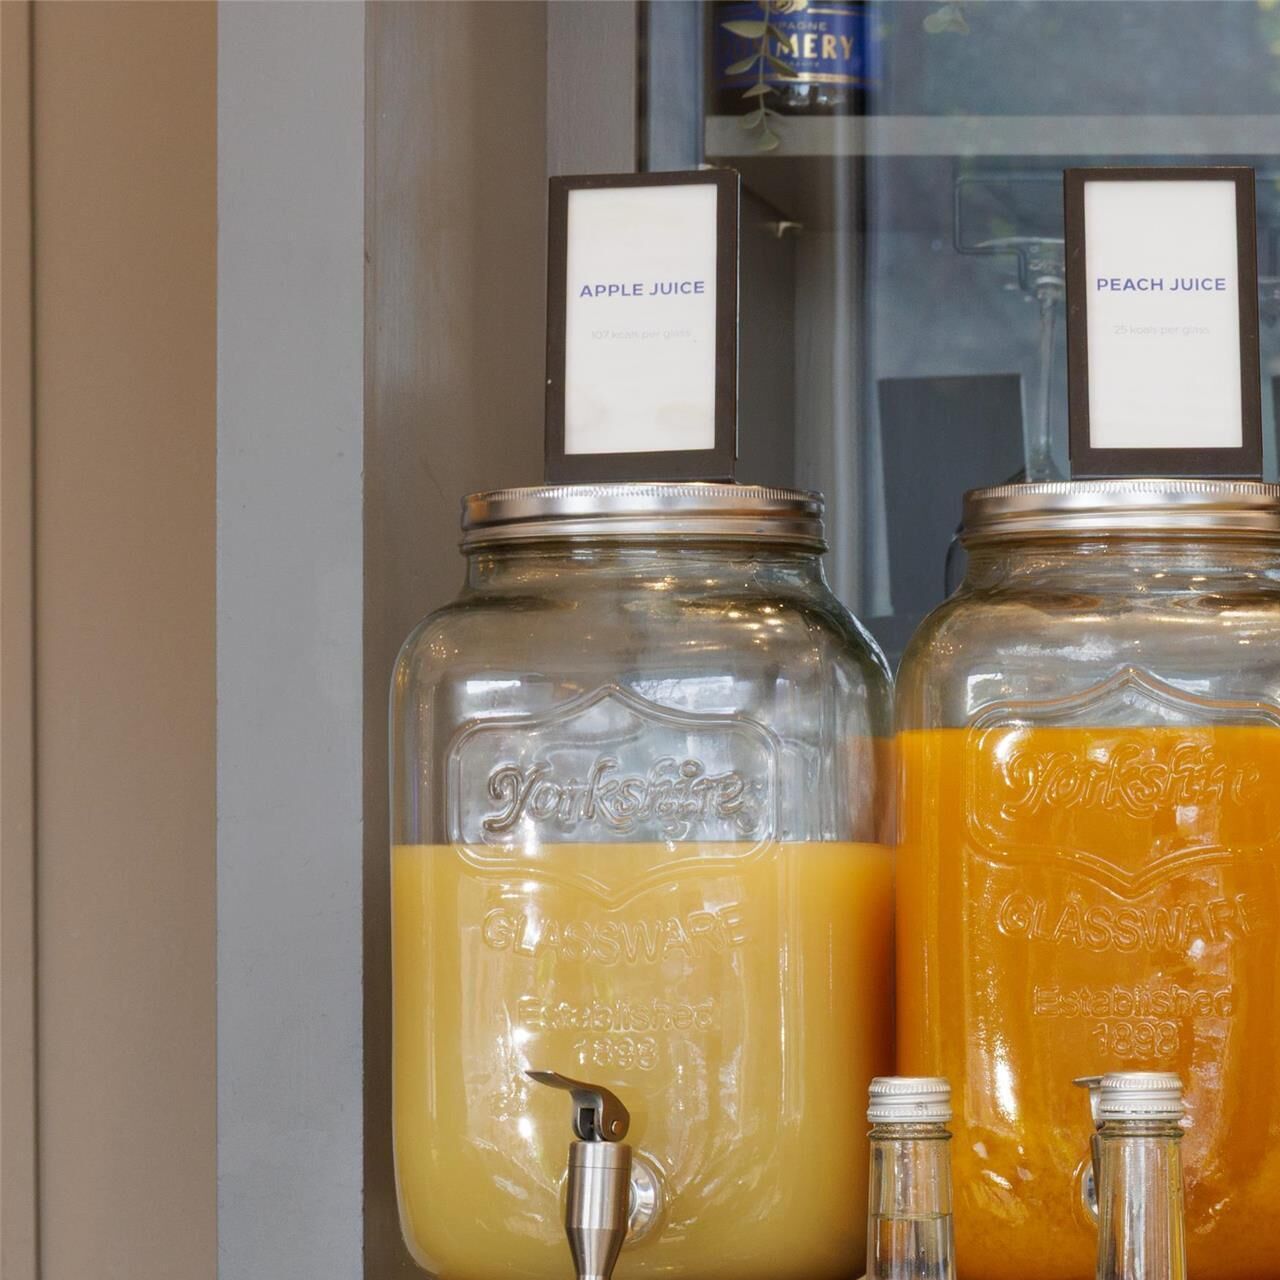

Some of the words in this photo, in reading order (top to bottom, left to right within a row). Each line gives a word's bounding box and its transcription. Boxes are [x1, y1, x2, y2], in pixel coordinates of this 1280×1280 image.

[579, 283, 643, 298] APPLE
[649, 281, 704, 296] JUICE
[1096, 278, 1163, 291] PEACH
[1170, 278, 1226, 291] JUICE
[483, 752, 750, 835] Yorkshire
[1001, 740, 1262, 821] Yorkshire
[481, 903, 750, 967] GLASSWARE
[997, 893, 1267, 954] GLASSWARE
[1033, 983, 1234, 1020] Established
[1091, 1020, 1179, 1060] 1898
